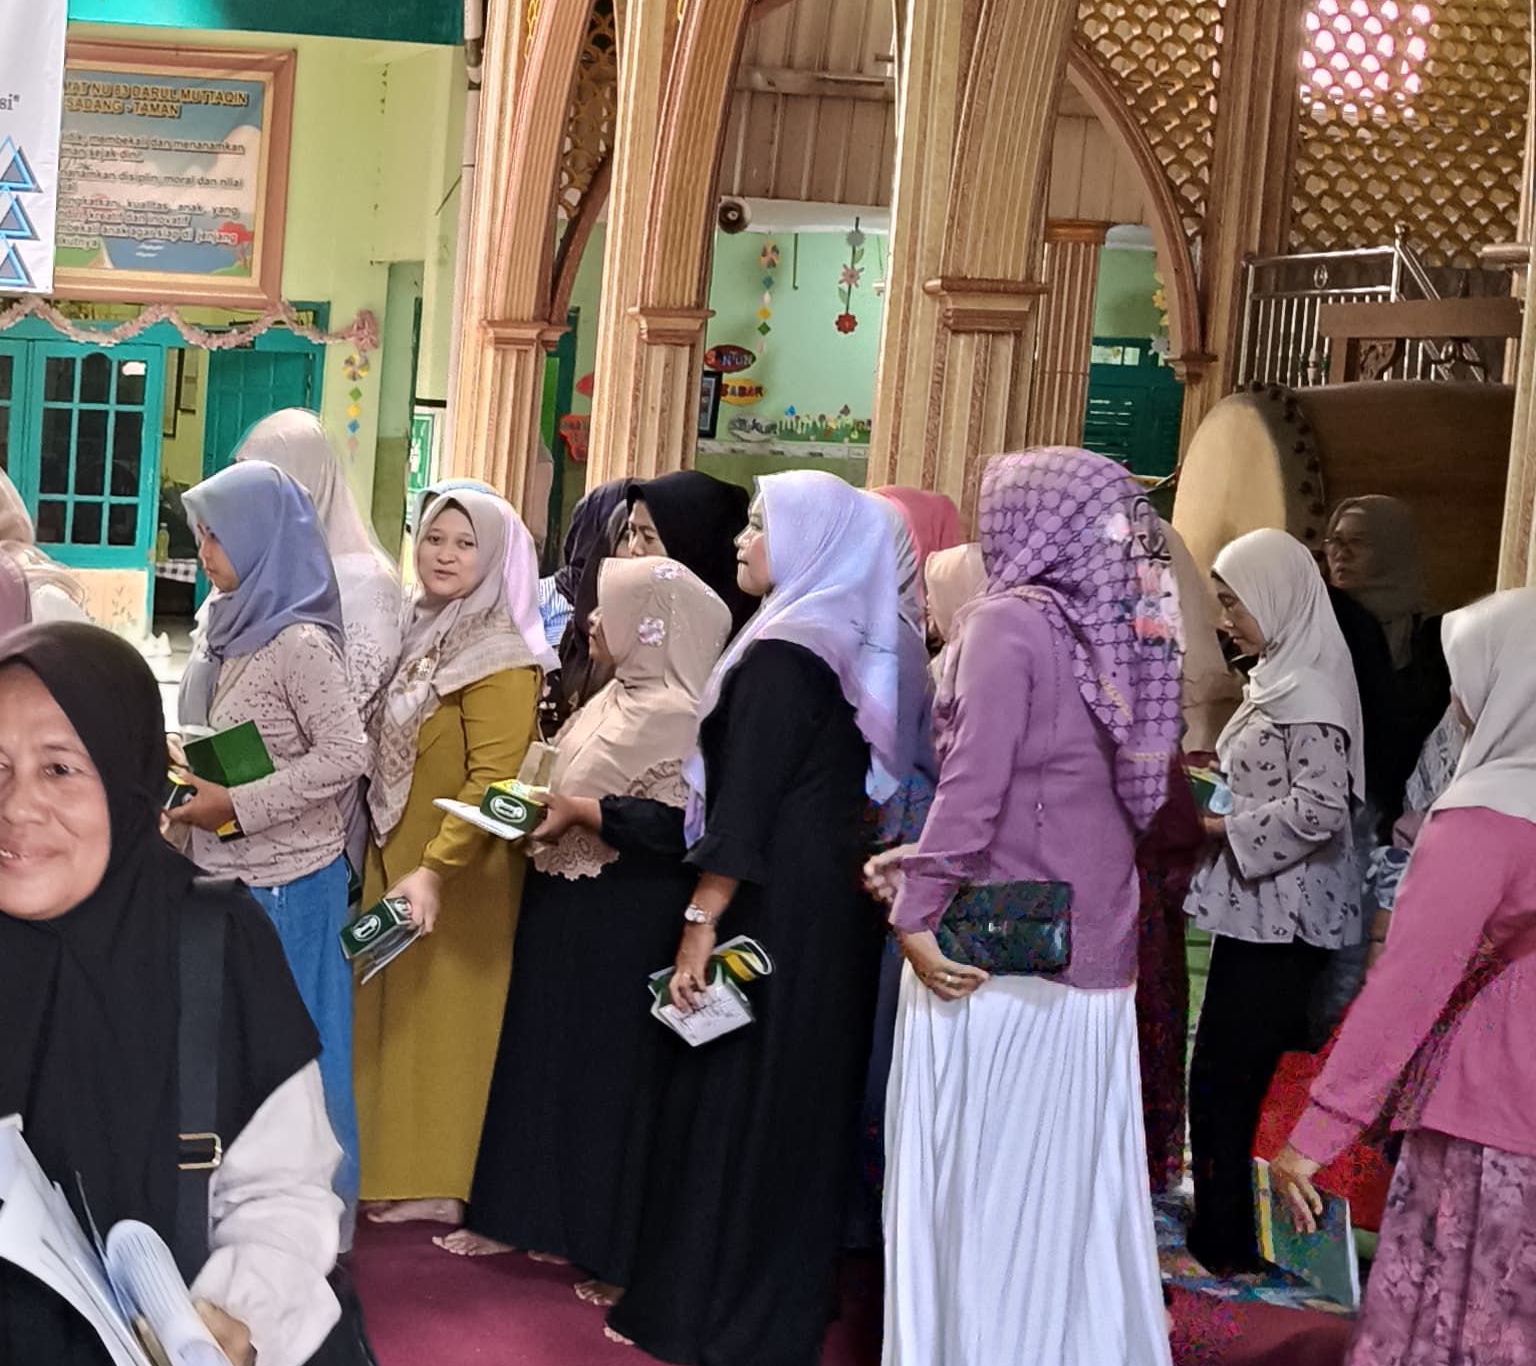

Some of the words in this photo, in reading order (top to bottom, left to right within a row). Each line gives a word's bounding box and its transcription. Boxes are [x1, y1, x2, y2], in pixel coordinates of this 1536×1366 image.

[132, 85, 177, 101] DARUL
[180, 88, 249, 106] MUTTAQIN
[132, 102, 181, 118] TAMAN
[197, 176, 217, 186] dan
